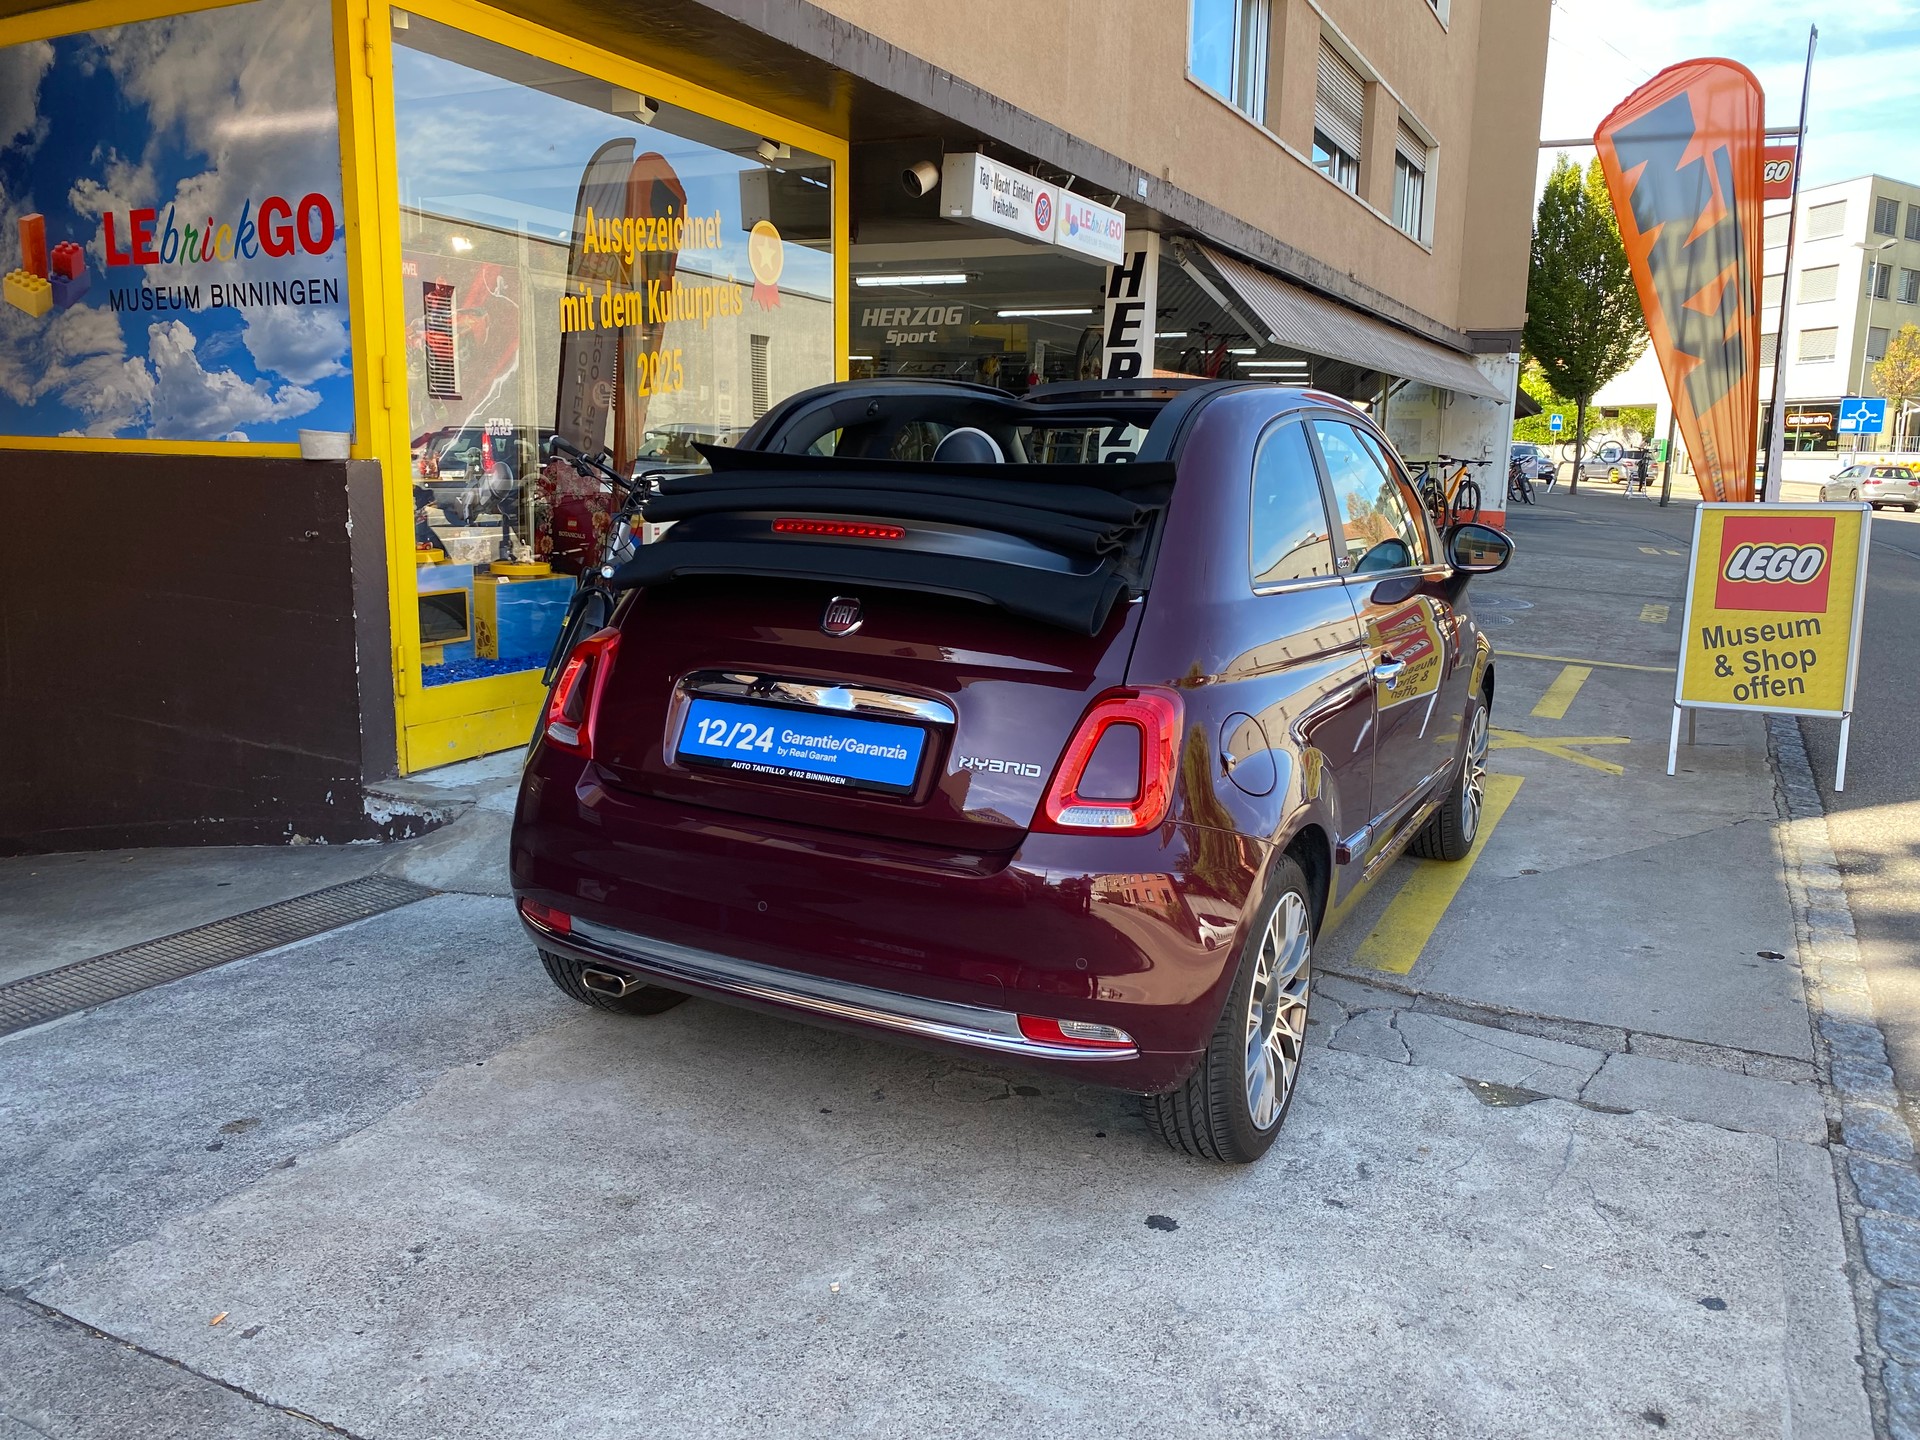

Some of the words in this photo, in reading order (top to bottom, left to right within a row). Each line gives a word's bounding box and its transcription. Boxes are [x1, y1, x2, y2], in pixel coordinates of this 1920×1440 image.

[980, 166, 990, 190] Tag
[993, 173, 1011, 195] Nacht
[1012, 180, 1034, 204] Einfahrt
[1764, 160, 1792, 183] GO
[992, 196, 1018, 220] freihalten
[103, 192, 335, 267] LEbrickGO
[583, 205, 722, 265] Ausgezeichnet
[401, 262, 417, 276] RVEL
[109, 285, 200, 312] MUSEUM
[211, 278, 339, 308] BINNINGEN
[559, 282, 595, 332] mit
[600, 280, 642, 329] dem
[647, 273, 742, 330] Kulturpreis
[861, 306, 964, 328] HERZOG
[886, 329, 938, 346] Sport
[637, 348, 684, 397] 2025
[485, 418, 513, 427] STAR
[485, 427, 513, 436] WARS
[583, 405, 595, 450] SHO
[1723, 542, 1827, 584] LEGO
[828, 605, 857, 624] FIAT
[1702, 617, 1821, 650] Museum
[1714, 654, 1735, 678] &
[1742, 648, 1817, 674] Shop
[1733, 676, 1805, 701] offen
[698, 718, 775, 753] 12/24
[781, 729, 907, 760] Garantie/Garanzia
[777, 746, 789, 756] by
[789, 748, 808, 758] Real
[809, 752, 837, 762] Garant
[958, 755, 1041, 778] HYBRID
[731, 762, 751, 770] AUTO
[752, 764, 785, 775] TANTILLO
[788, 770, 805, 779] 4102
[805, 772, 846, 784] BINNINGEN
